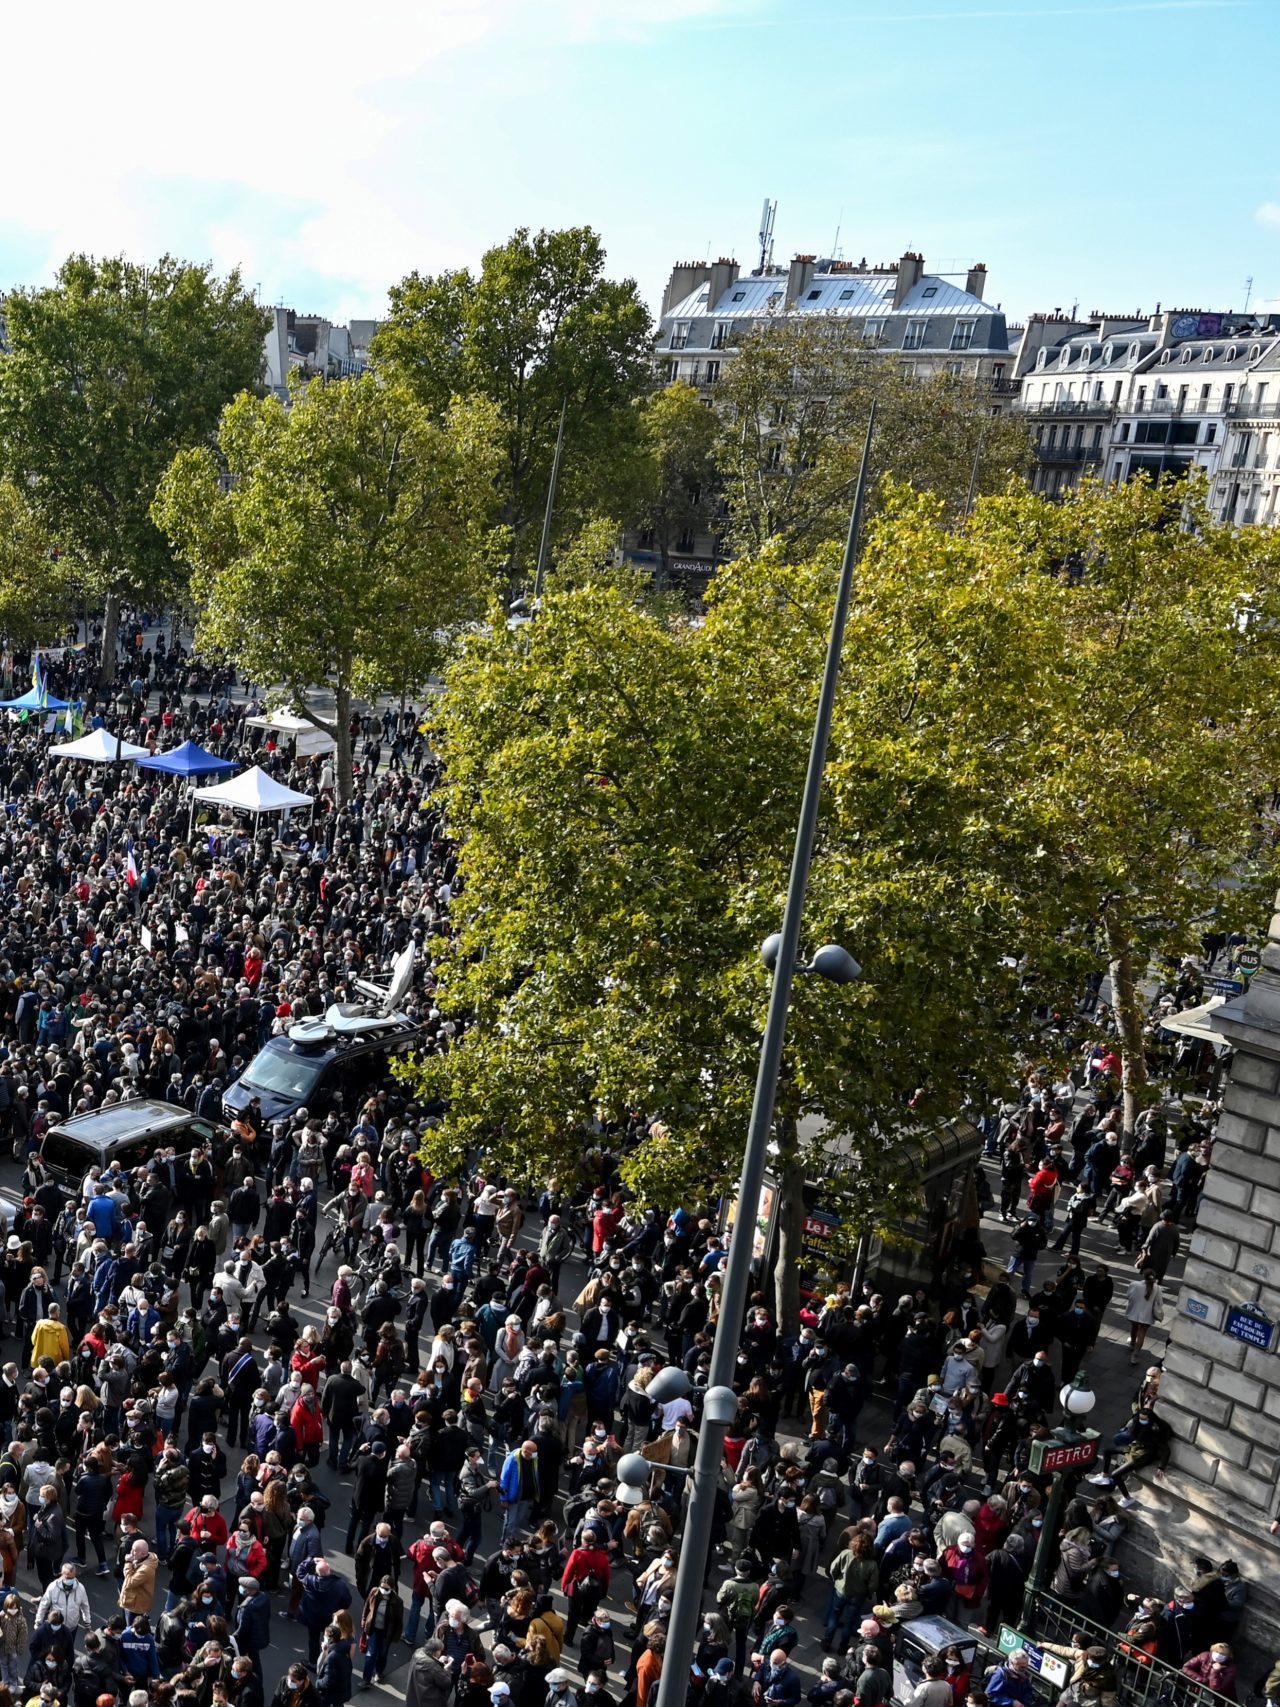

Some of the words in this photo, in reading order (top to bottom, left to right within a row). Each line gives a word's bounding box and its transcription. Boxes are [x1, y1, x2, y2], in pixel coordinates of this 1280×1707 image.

[1241, 955, 1259, 965] BUS
[1232, 1319, 1265, 1338] FAUBOURG
[1239, 1315, 1253, 1326] RUE
[1254, 1322, 1263, 1330] DU
[1230, 1326, 1239, 1334] DU
[1240, 1330, 1266, 1346] TEMPLE
[1045, 1444, 1092, 1467] METRO
